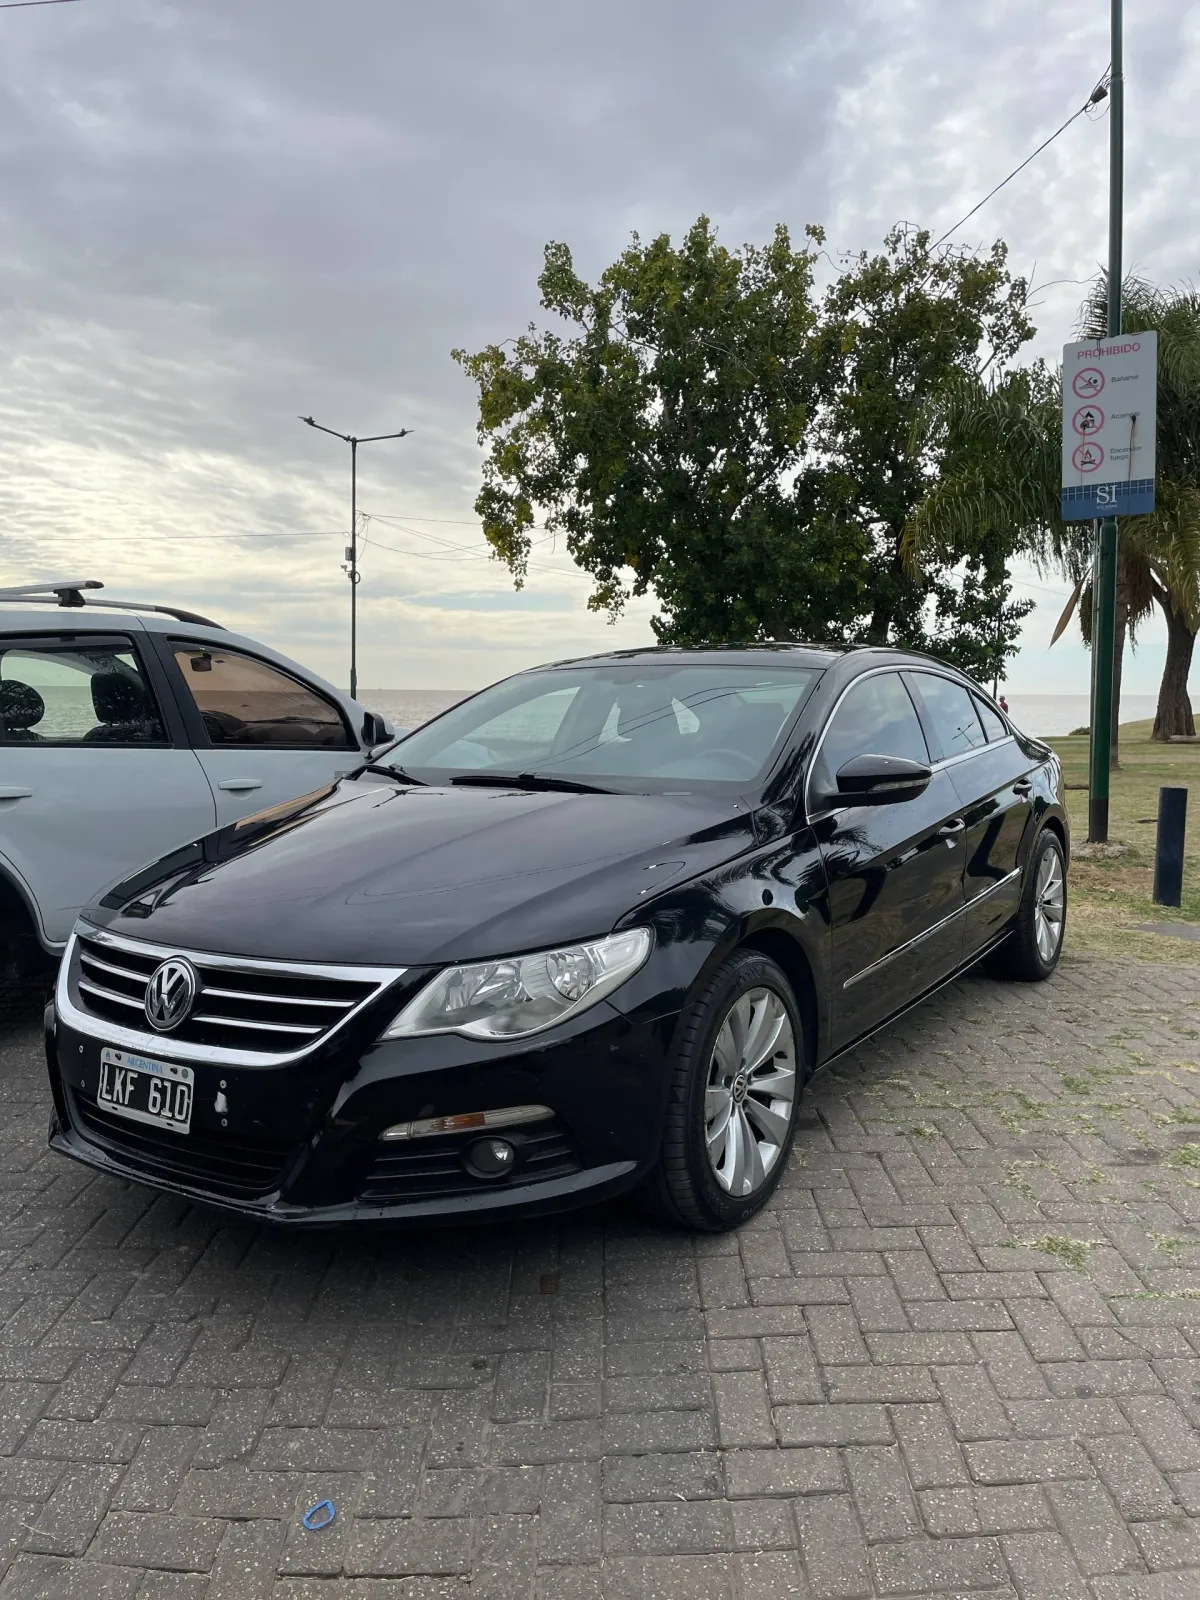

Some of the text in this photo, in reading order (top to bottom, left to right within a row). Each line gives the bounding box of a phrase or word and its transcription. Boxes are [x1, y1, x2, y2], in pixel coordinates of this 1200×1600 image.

[1077, 342, 1141, 360] PROHIBIDO
[1096, 485, 1118, 504] SI
[148, 960, 193, 1027] VW
[126, 1056, 165, 1074] ARGENTINA
[102, 1064, 189, 1121] LKF 610
